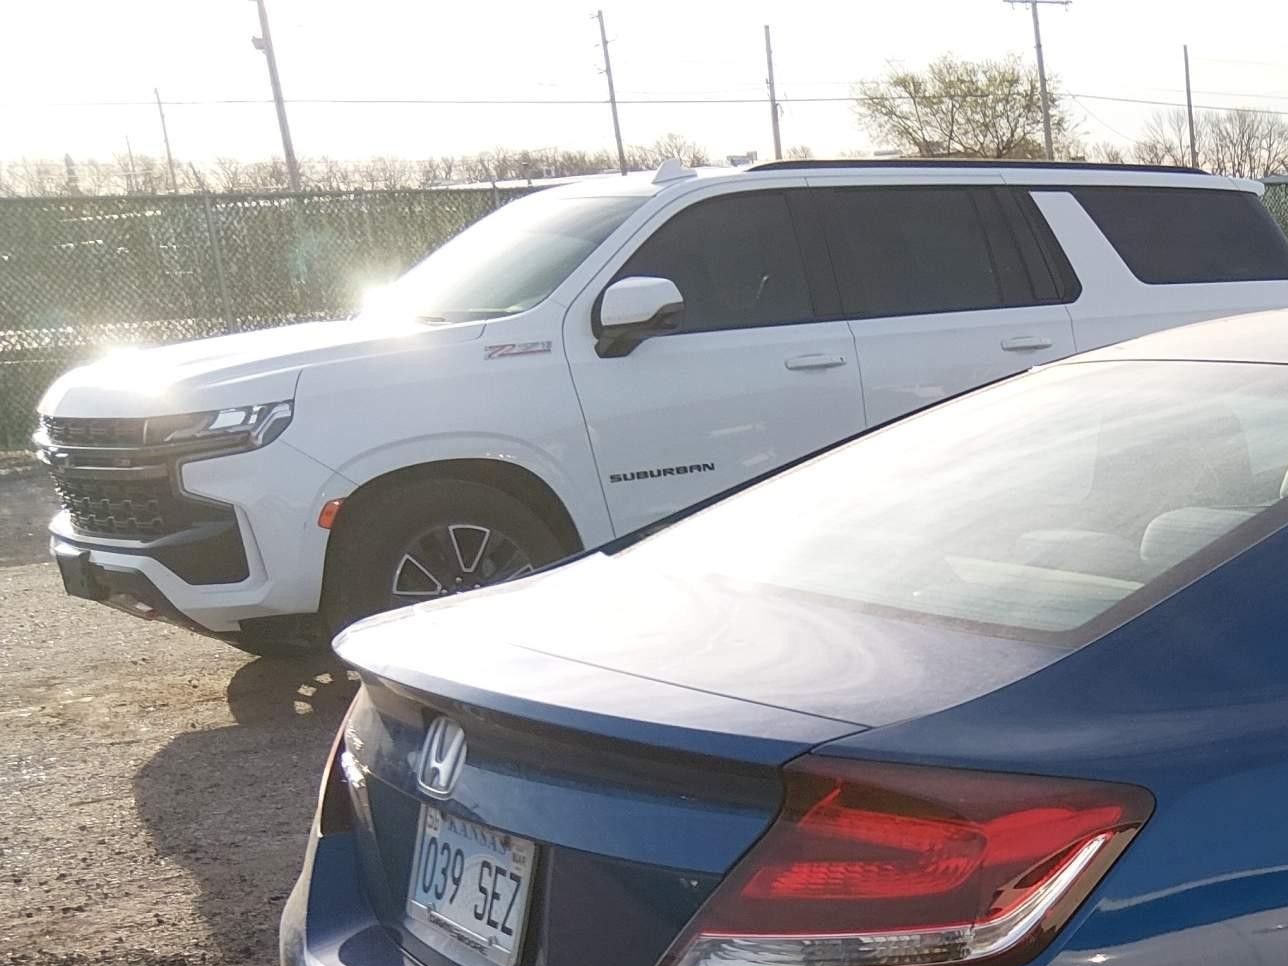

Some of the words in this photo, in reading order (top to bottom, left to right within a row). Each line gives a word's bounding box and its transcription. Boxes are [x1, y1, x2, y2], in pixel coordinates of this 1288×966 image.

[609, 462, 716, 483] SUBURBAN
[422, 836, 465, 905] 039
[473, 859, 523, 937] SEZ
